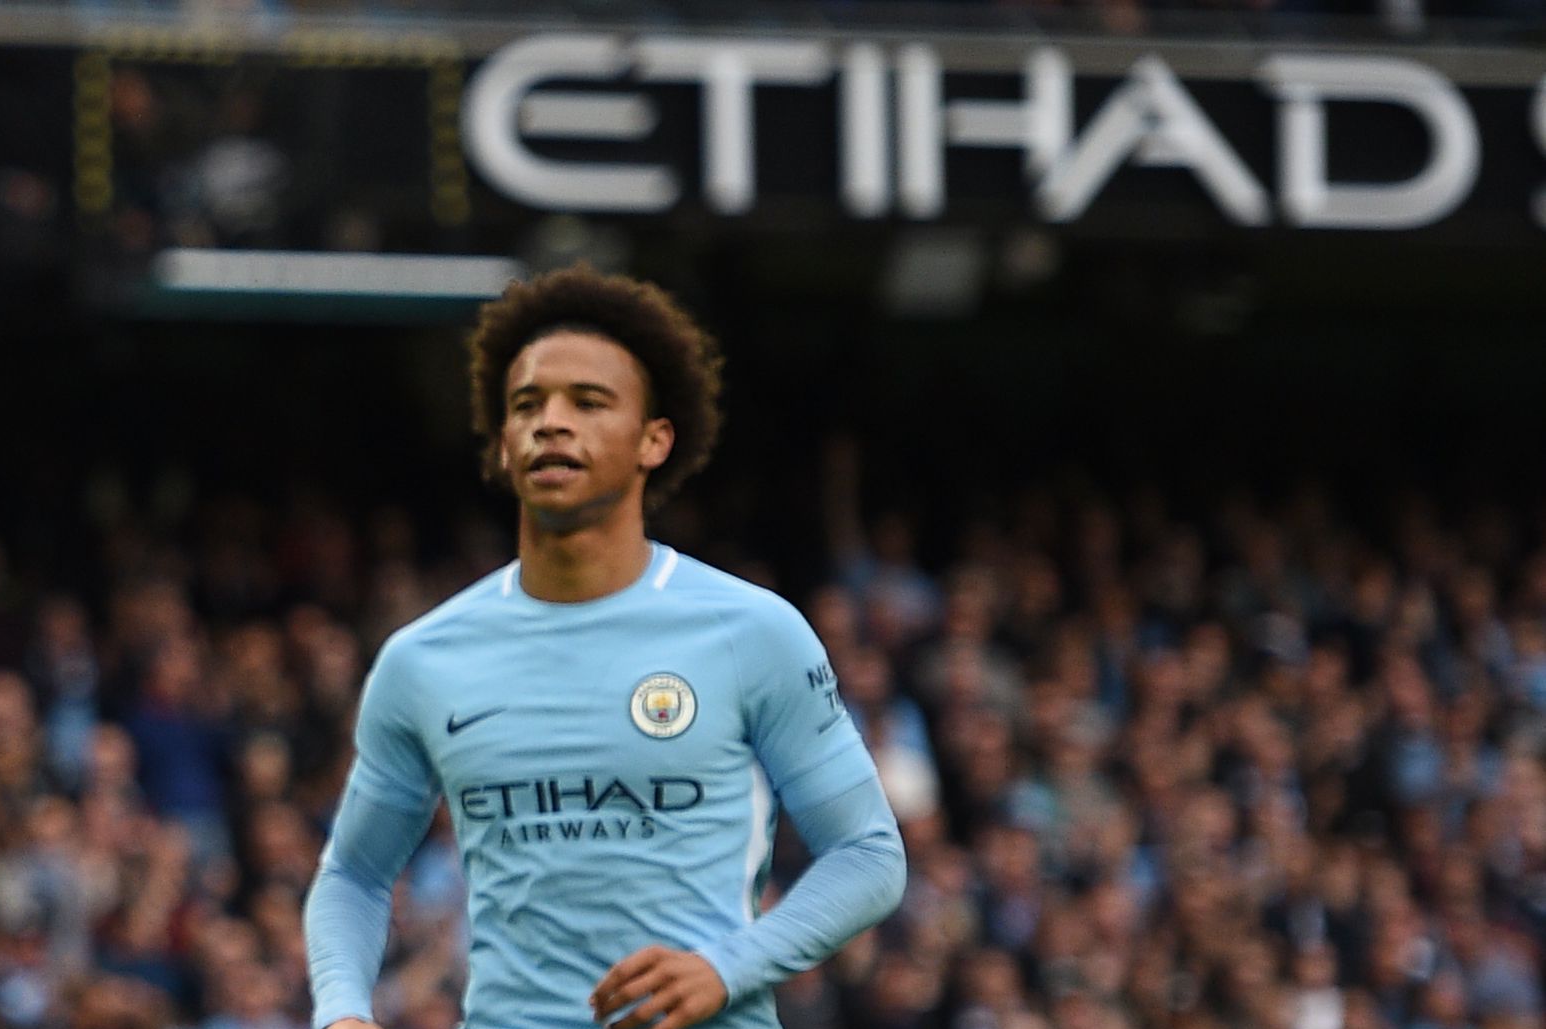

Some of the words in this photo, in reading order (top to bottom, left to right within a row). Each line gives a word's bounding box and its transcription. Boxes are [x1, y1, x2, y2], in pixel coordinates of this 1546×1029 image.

[462, 33, 1482, 230] ETIHAD
[461, 776, 704, 821] ETIHAD
[502, 815, 656, 848] AIRWAYS
